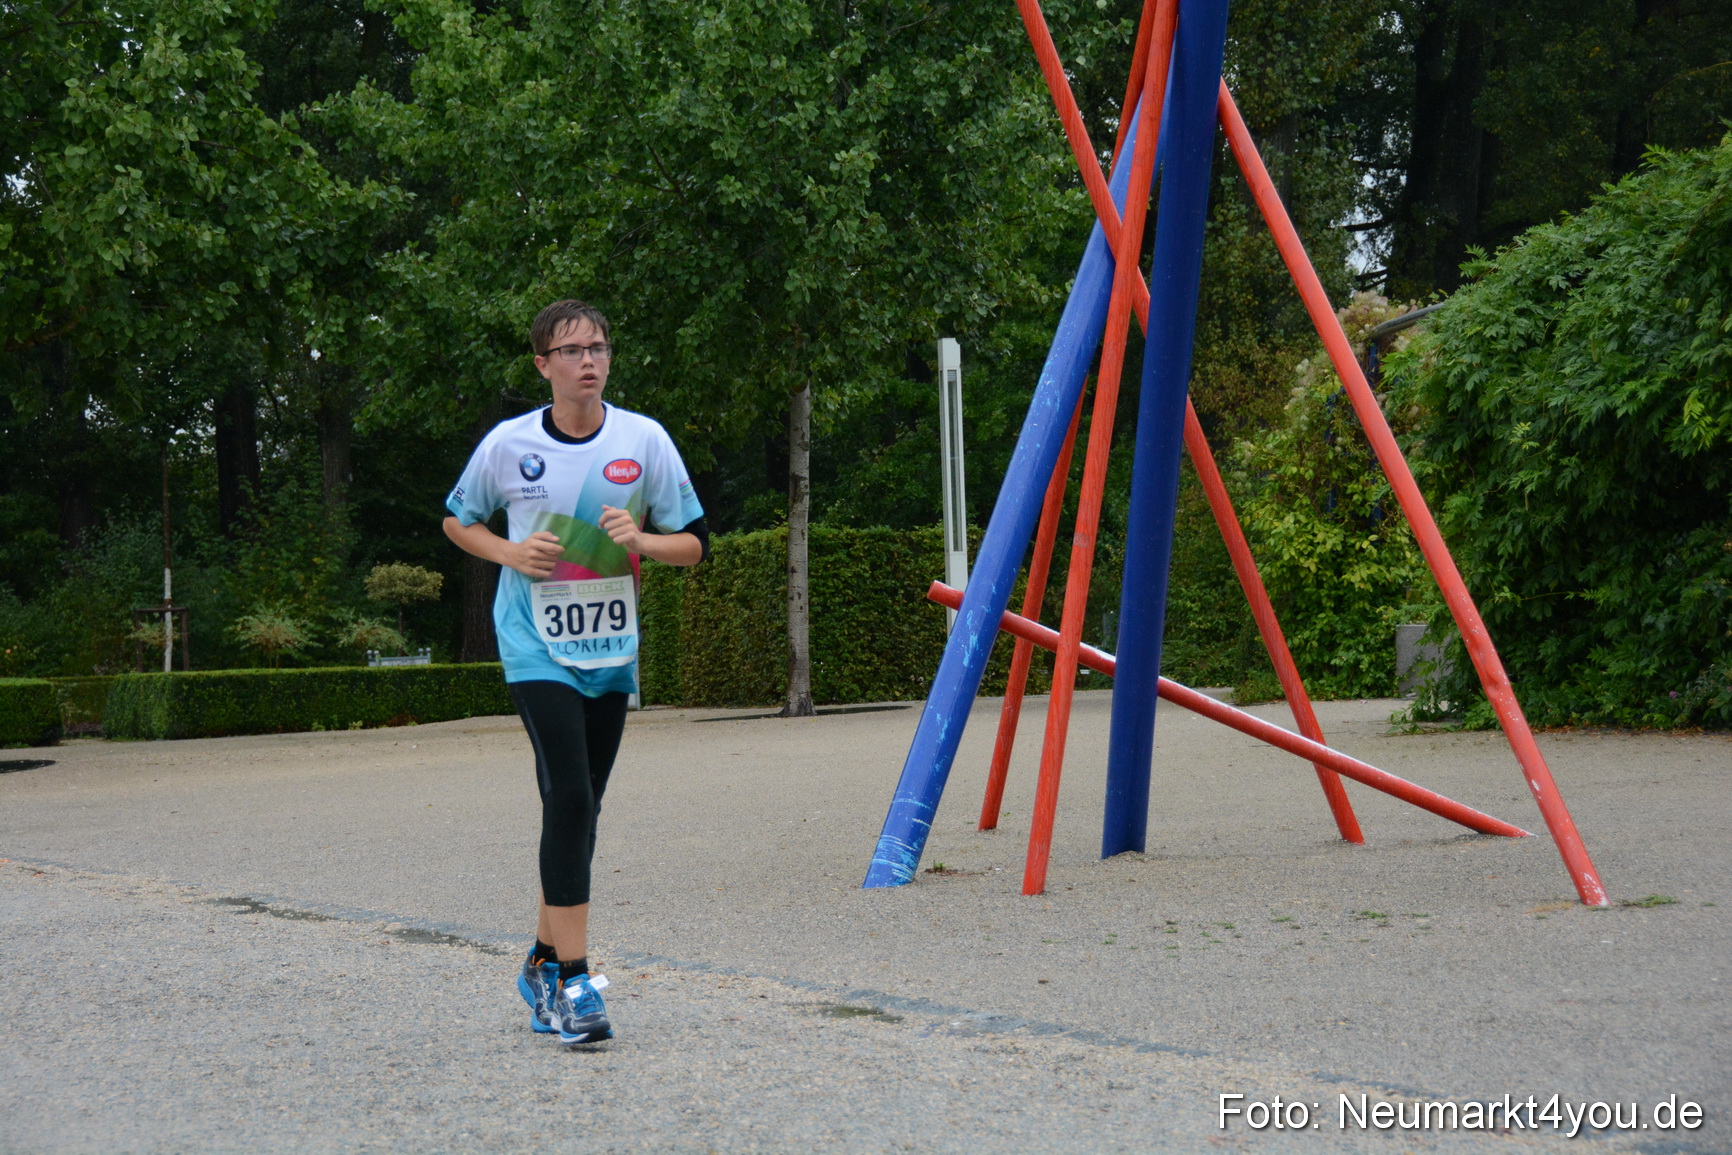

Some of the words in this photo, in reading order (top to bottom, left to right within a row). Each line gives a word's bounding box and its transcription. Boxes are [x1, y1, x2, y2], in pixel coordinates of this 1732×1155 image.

[609, 466, 638, 478] Hervis
[521, 485, 548, 494] PARTL
[577, 581, 625, 594] BOCK
[544, 599, 627, 637] 3079
